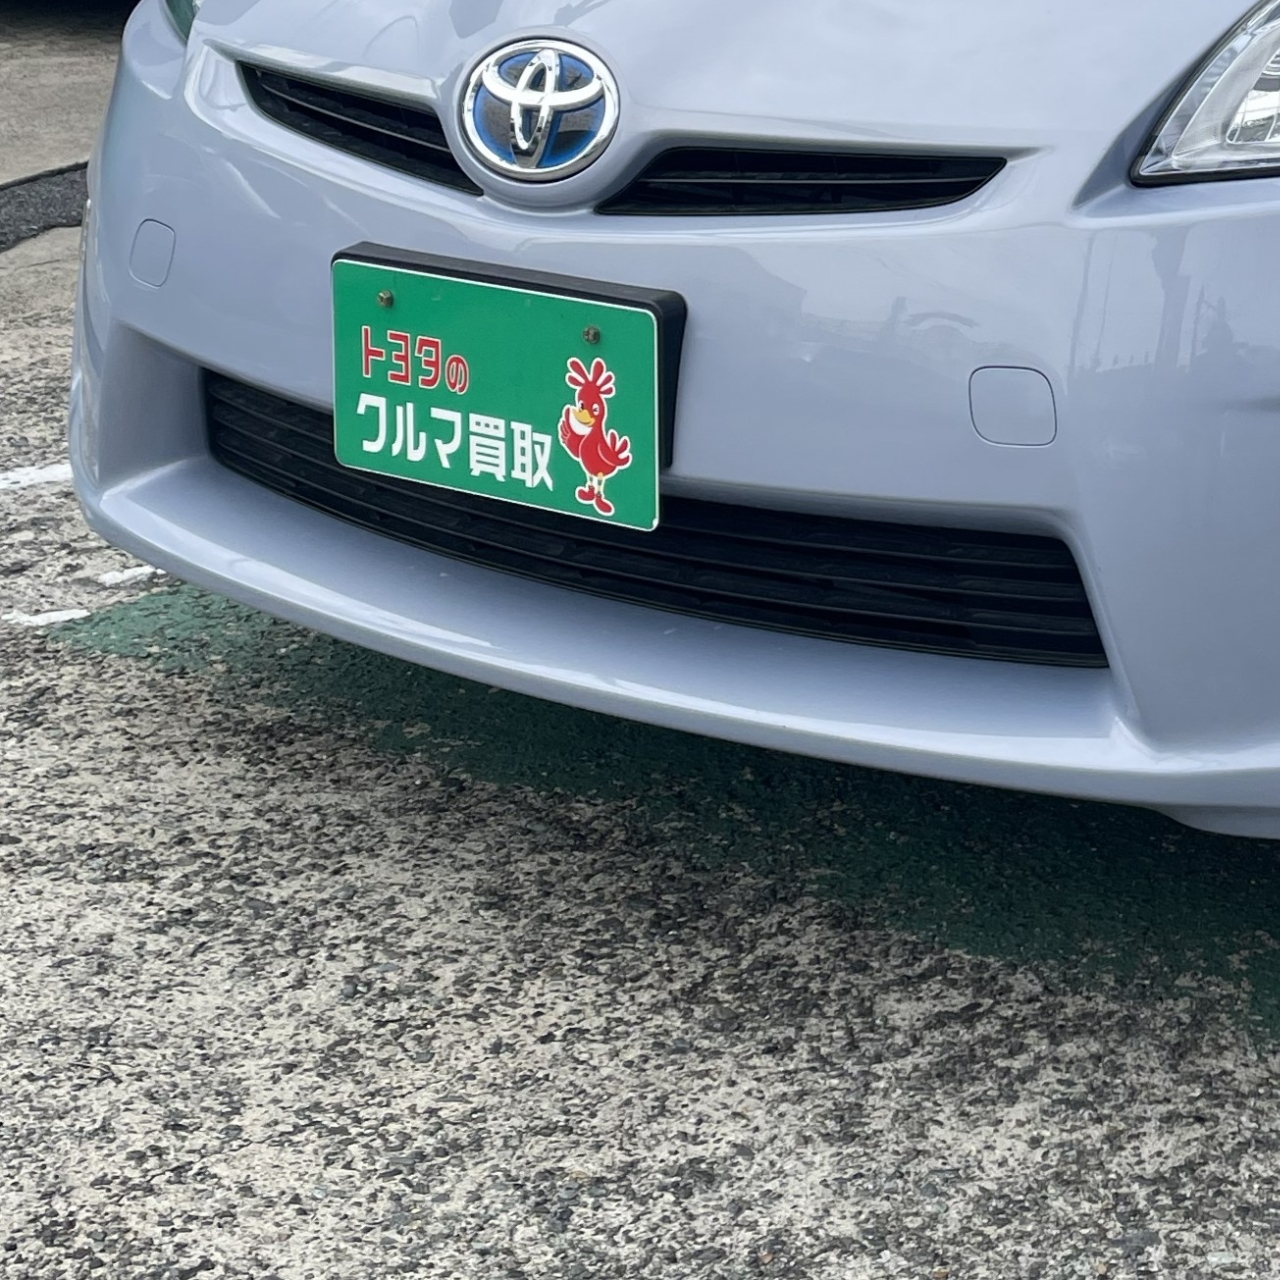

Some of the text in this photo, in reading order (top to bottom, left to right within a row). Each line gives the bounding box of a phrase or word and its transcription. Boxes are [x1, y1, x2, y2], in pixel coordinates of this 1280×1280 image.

[361, 325, 469, 394] トヨタの
[356, 392, 554, 491] クルマ買取
